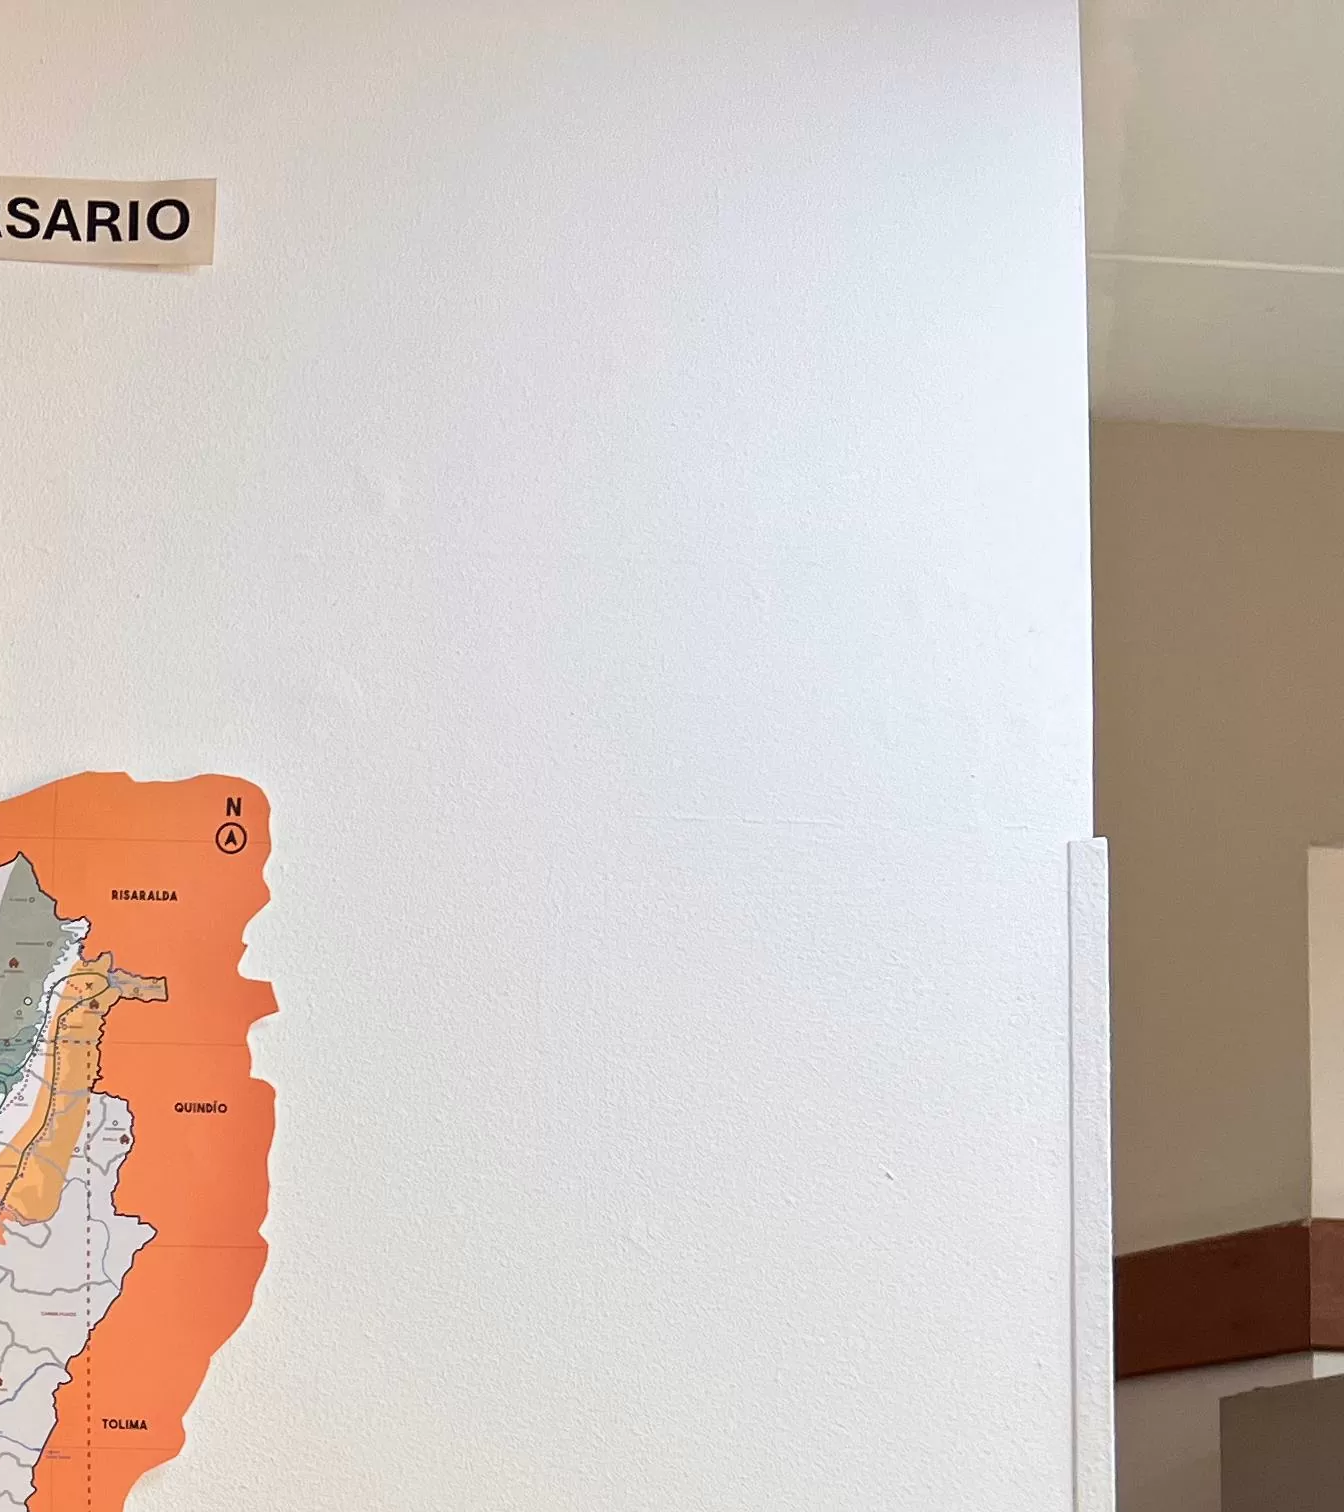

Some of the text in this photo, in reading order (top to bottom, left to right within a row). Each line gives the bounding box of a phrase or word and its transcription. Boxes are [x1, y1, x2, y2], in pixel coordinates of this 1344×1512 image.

[225, 797, 242, 817] N
[111, 889, 178, 902] RISARALDA
[174, 1100, 228, 1114] QUINDÍO
[101, 1417, 148, 1430] TOLIMA
